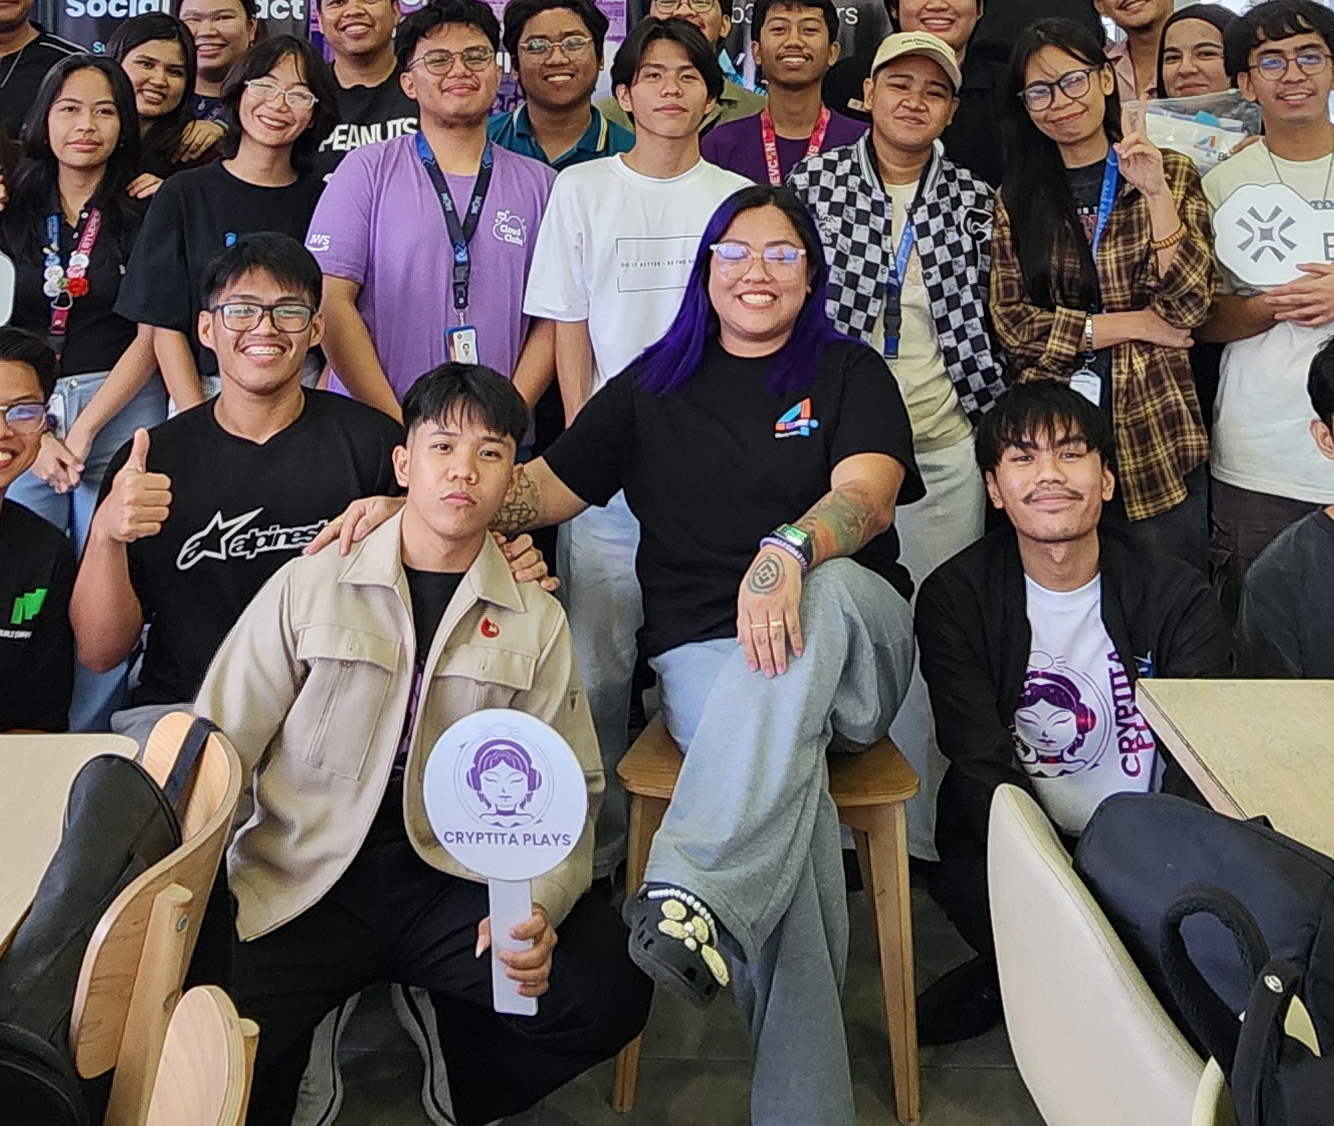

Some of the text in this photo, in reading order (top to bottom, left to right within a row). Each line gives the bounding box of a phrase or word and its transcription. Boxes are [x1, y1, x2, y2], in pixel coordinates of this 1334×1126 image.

[500, 224, 521, 236] Cloud
[443, 831, 572, 847] CRYPTITA PLAYS
